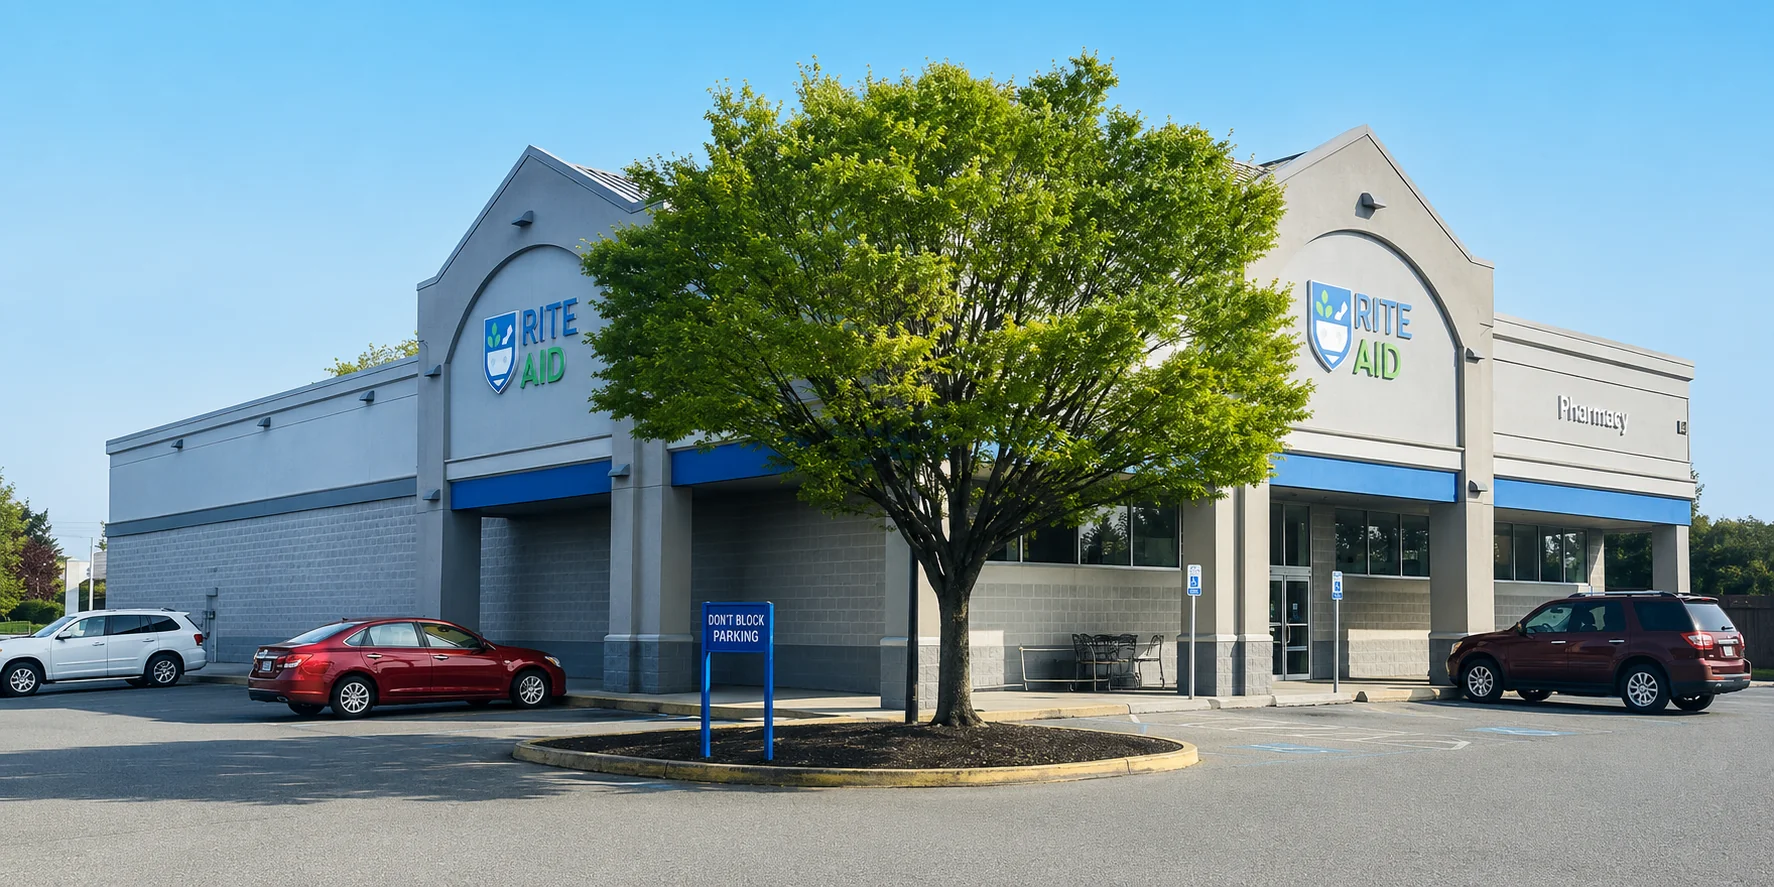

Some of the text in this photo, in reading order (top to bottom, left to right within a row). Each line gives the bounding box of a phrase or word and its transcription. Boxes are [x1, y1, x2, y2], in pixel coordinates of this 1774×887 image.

[522, 297, 579, 346] RITE
[1354, 293, 1413, 340] RITE
[520, 346, 567, 389] AID
[1352, 338, 1402, 381] AID
[1557, 394, 1629, 437] Pharmacy
[708, 614, 764, 626] DON'T BLOCK
[713, 630, 759, 642] PARKING
